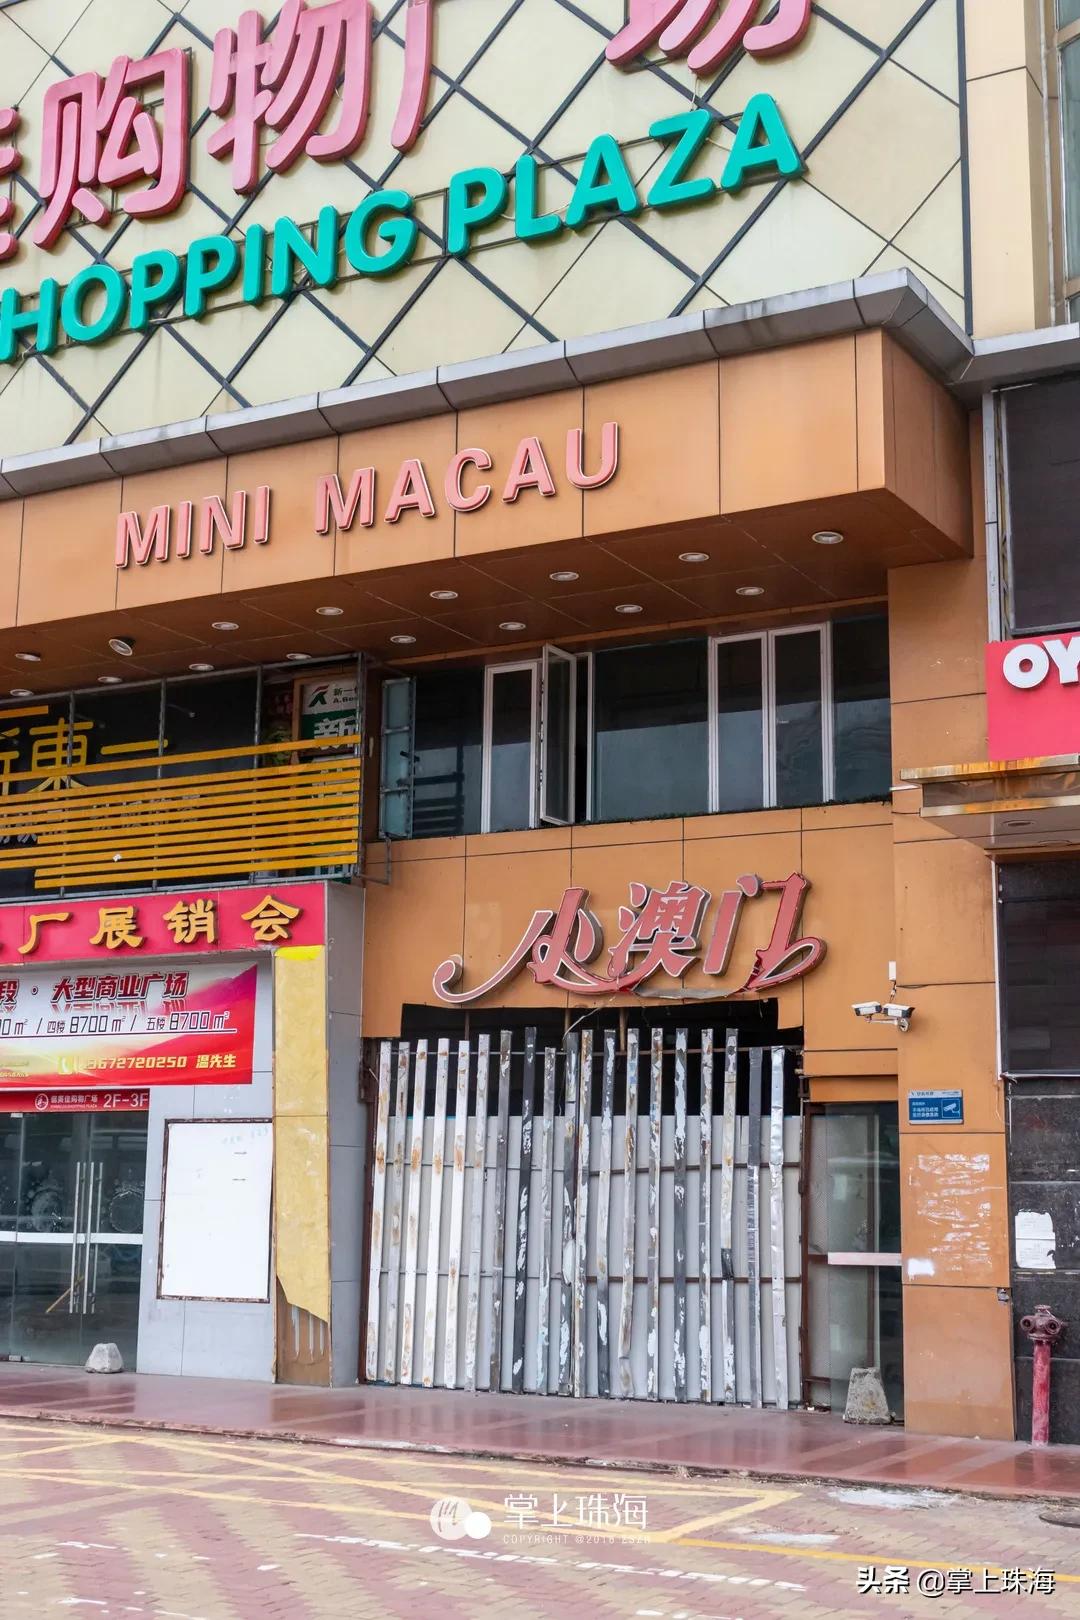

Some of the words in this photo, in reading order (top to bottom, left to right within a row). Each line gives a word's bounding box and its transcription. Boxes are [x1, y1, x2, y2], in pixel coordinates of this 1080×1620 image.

[446, 93, 801, 258] PLAZA
[114, 484, 271, 569] MINI
[314, 421, 619, 536] MACAU
[432, 872, 828, 1004] 小澳门
[103, 1092, 149, 1108] 2F-3F
